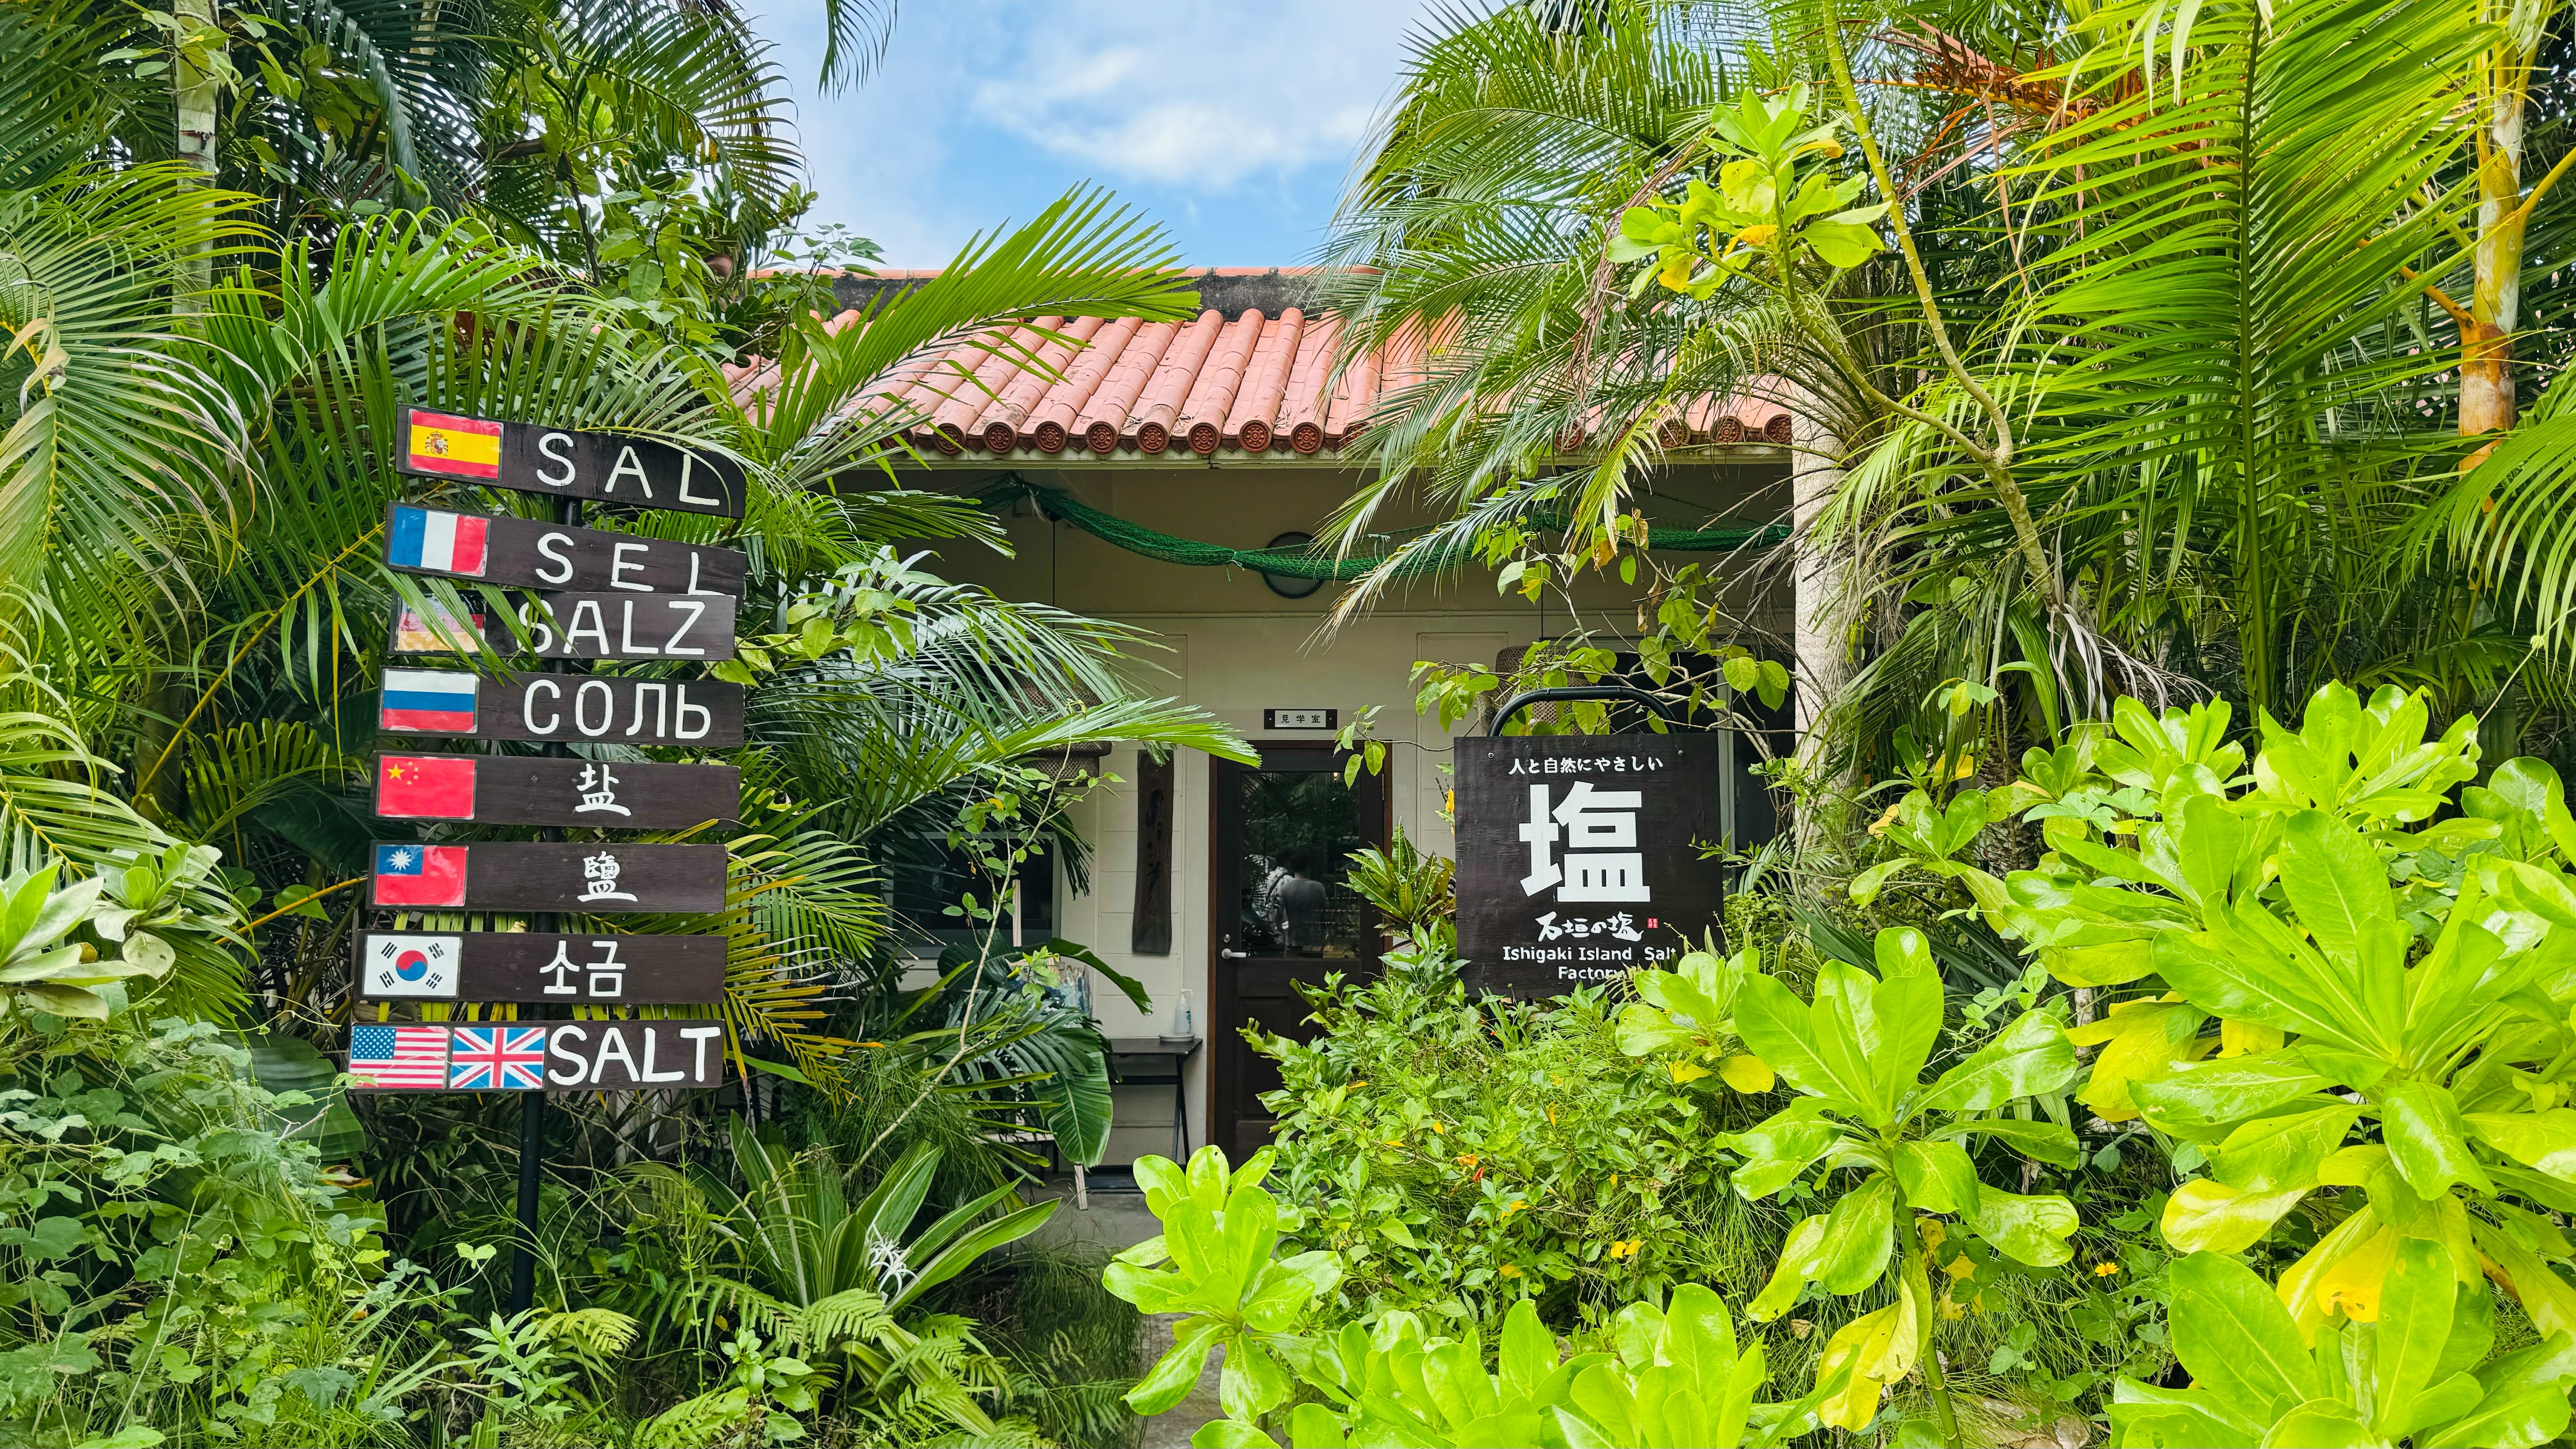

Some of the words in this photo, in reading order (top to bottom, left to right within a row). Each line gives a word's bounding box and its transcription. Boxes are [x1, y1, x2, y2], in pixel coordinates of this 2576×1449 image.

[537, 432, 720, 506] SAL
[535, 532, 727, 595] SEL
[516, 599, 706, 655] SALZ
[524, 679, 711, 739] СОЛЬ
[1281, 714, 1320, 723] 見学室
[575, 763, 631, 816] 盐
[1509, 756, 1663, 775] 人と自然にやさしい
[1518, 781, 1651, 902] 塩
[577, 851, 638, 902] 鹽
[1503, 946, 1572, 962] Ishigaki
[1578, 947, 1632, 961] Island
[1535, 911, 1644, 942] 石垣の塩
[539, 940, 626, 997] 소금
[548, 1025, 721, 1086] SALT
